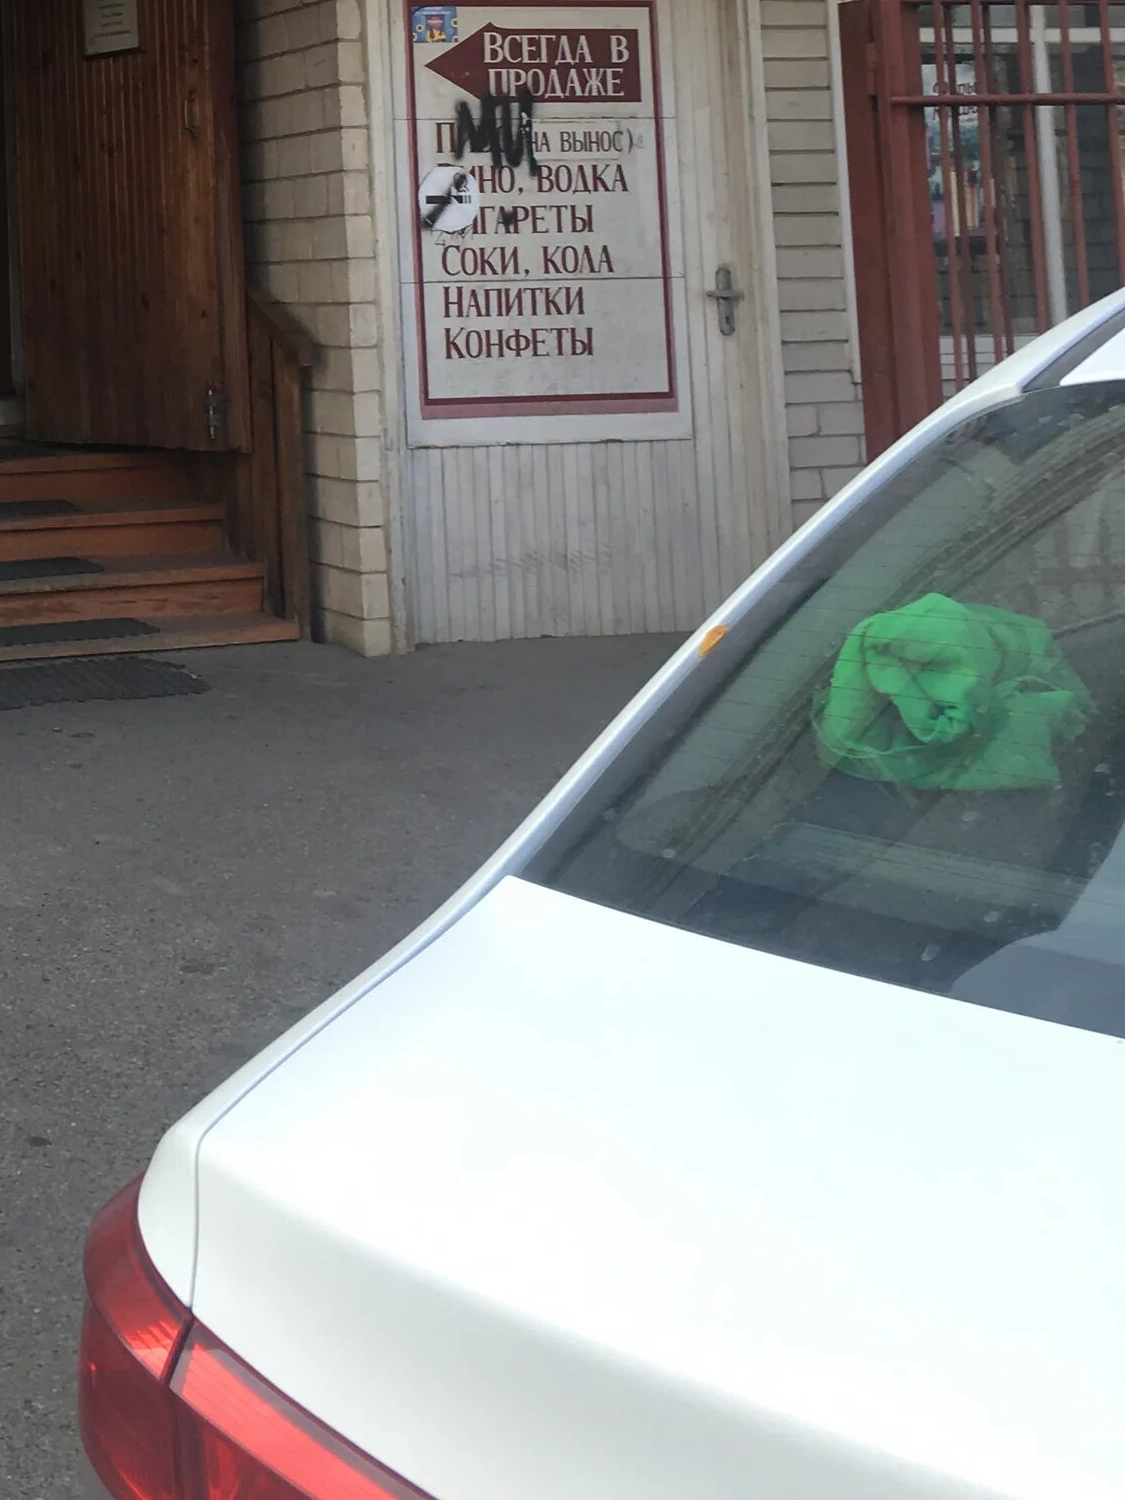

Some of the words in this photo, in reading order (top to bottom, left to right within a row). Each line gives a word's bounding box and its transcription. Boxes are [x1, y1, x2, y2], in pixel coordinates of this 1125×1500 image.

[611, 35, 629, 64] В
[488, 68, 625, 99] ПРОДАЖЕ
[537, 164, 629, 195] ВОДКА
[455, 204, 594, 235] ГАРЕТЫ
[441, 244, 530, 278] СОКИ,
[542, 244, 614, 275] КОЛА
[443, 286, 585, 318] НАПИТКИ
[444, 327, 593, 360] КОНФЕТЫ
